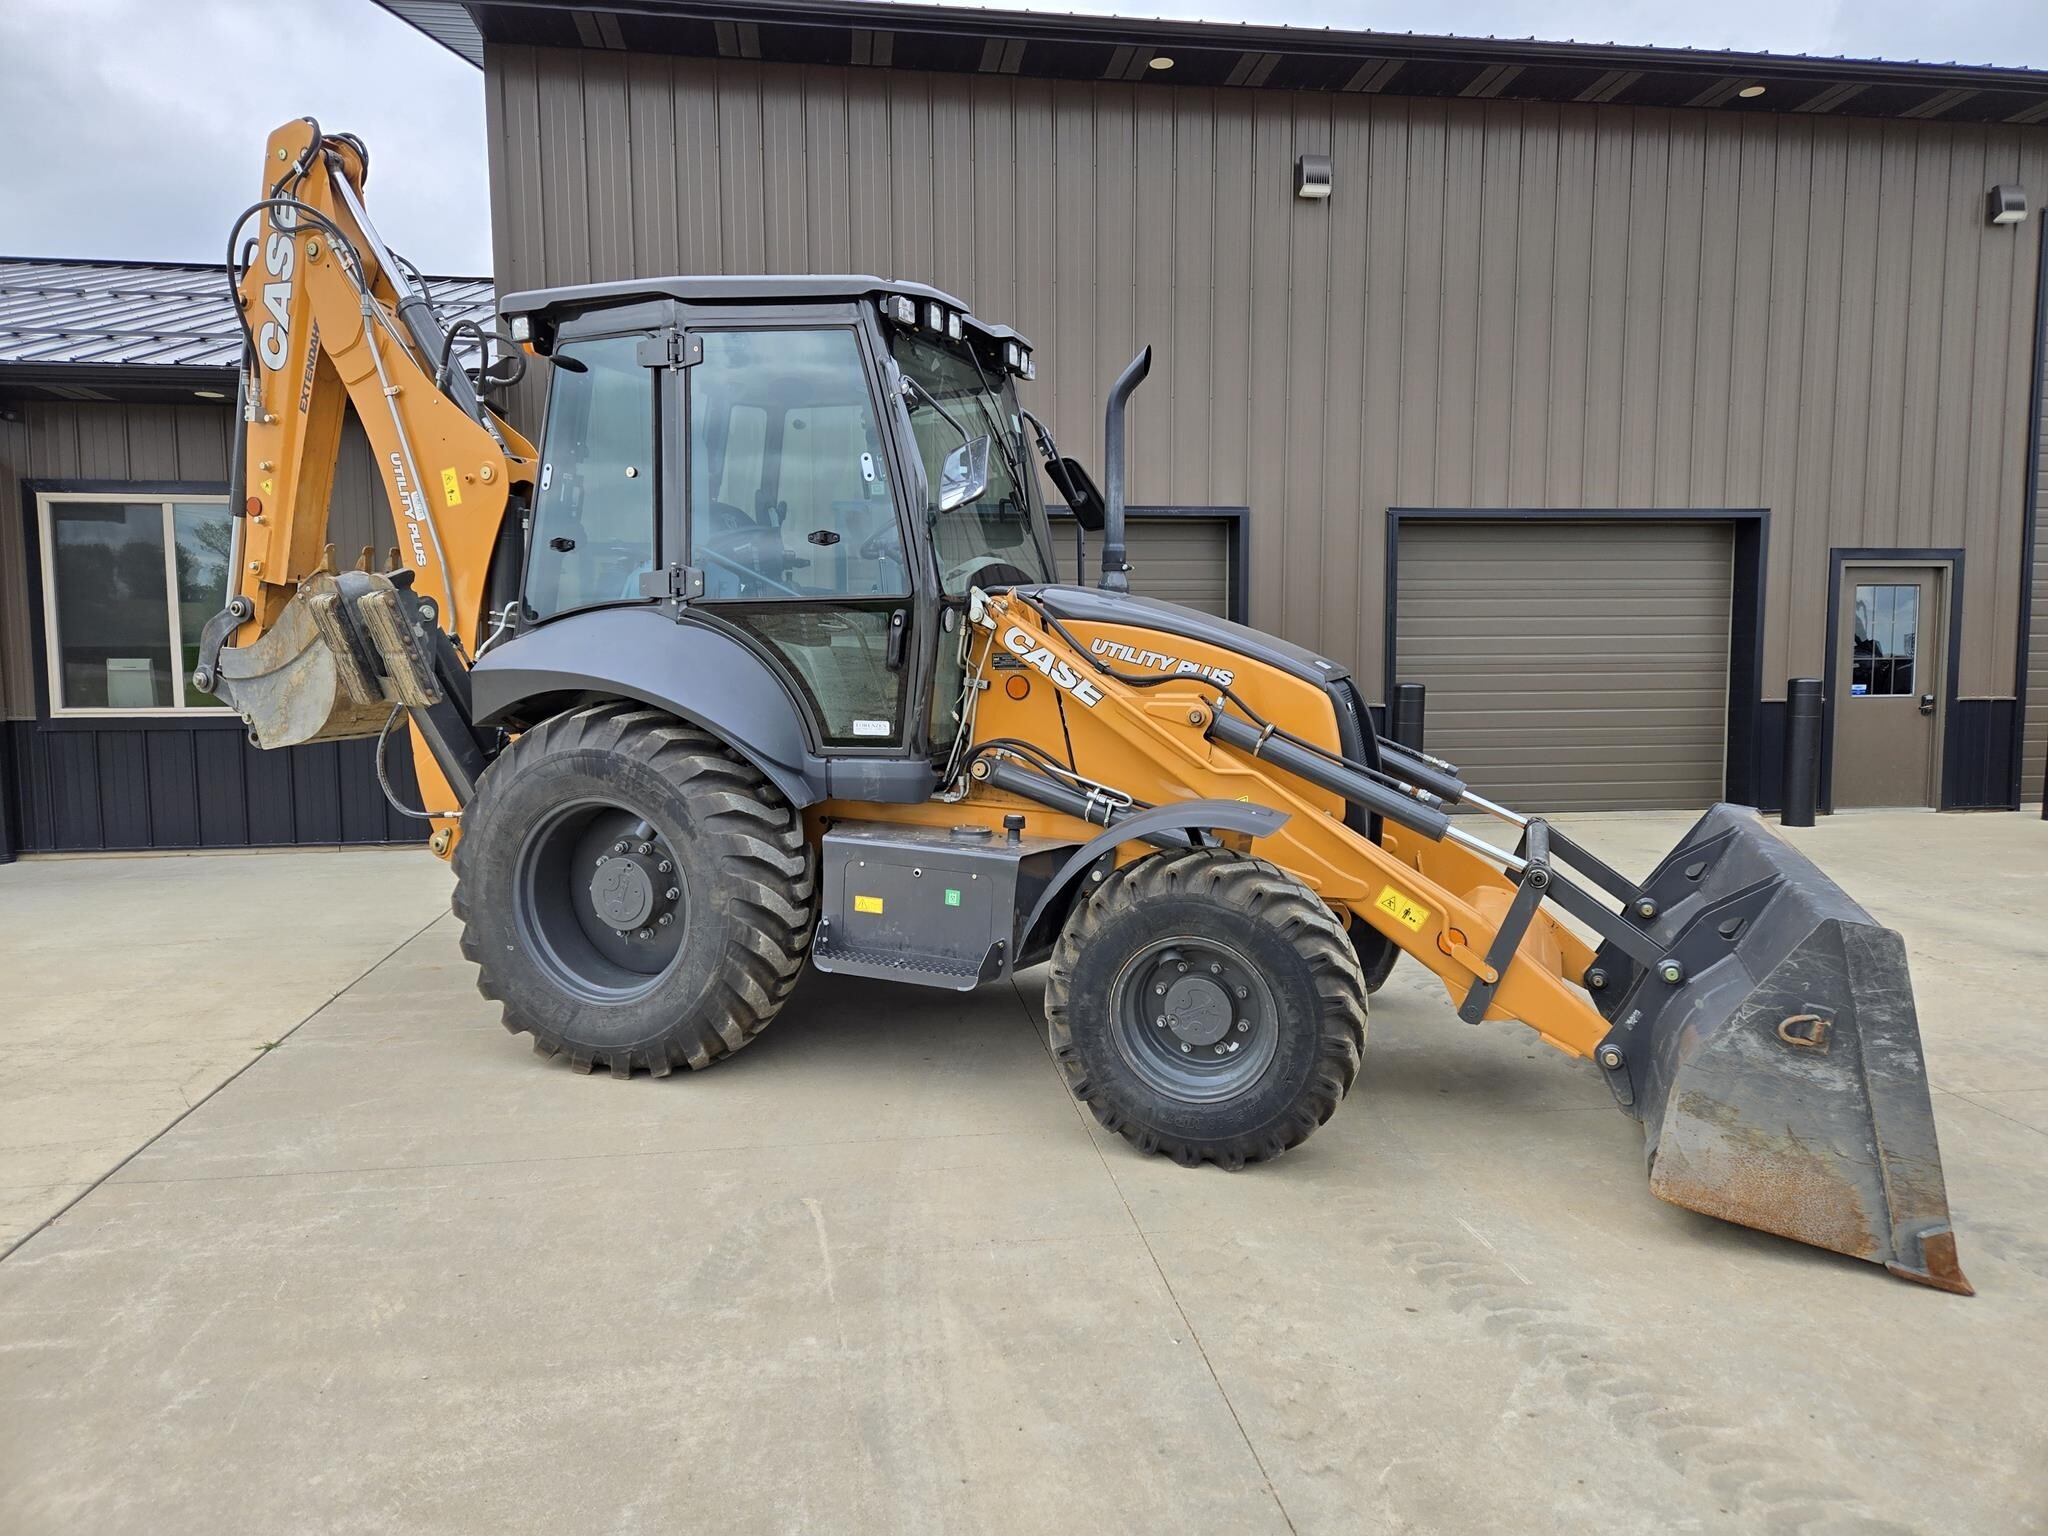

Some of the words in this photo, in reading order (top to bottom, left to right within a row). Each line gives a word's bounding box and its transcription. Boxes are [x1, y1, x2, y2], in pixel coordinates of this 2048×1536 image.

[260, 184, 299, 371] CASE
[299, 317, 320, 413] EXTENDAH
[389, 452, 417, 521] UTILITY
[407, 522, 427, 568] PLUS
[1003, 625, 1106, 708] CASE
[1090, 637, 1179, 672] UTILITY
[1175, 659, 1236, 688] PLUS
